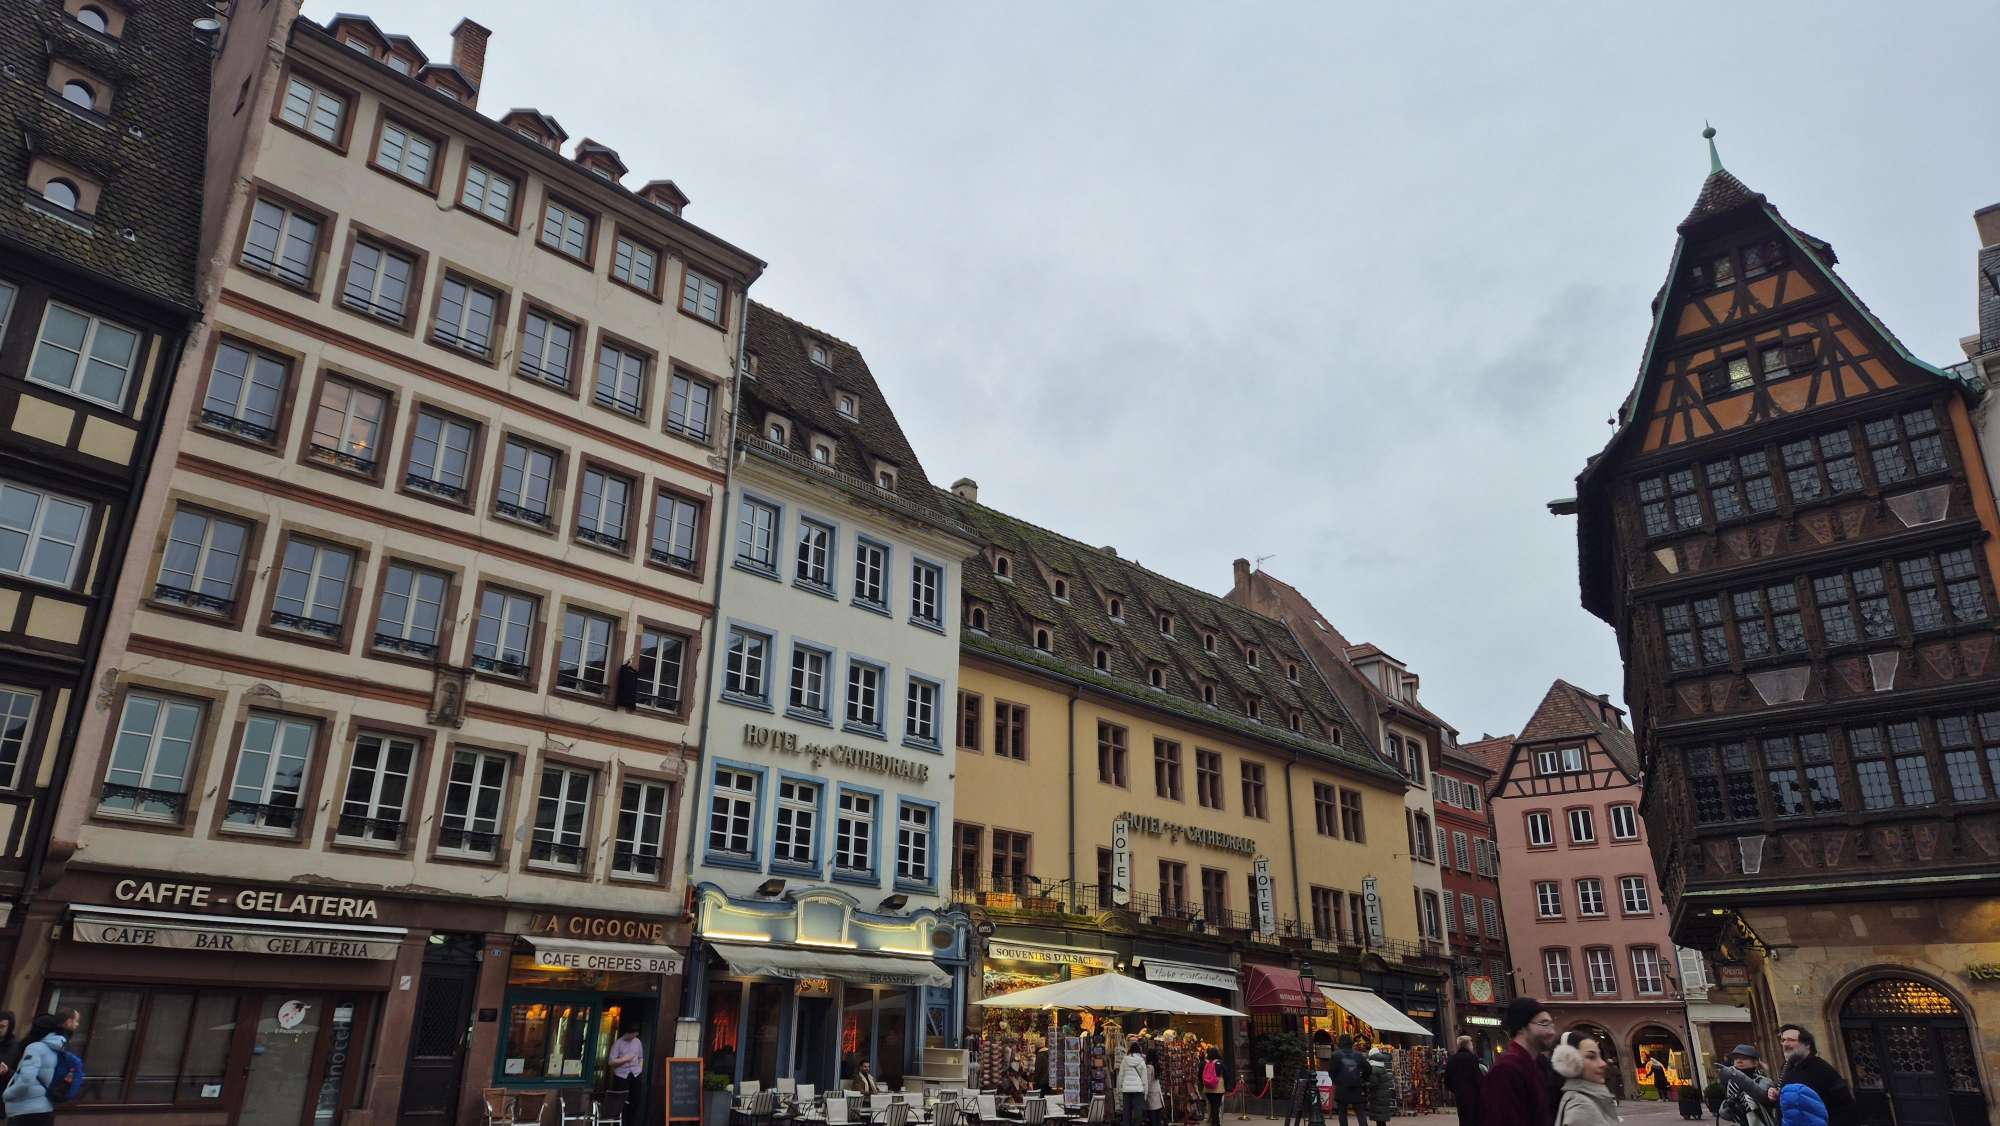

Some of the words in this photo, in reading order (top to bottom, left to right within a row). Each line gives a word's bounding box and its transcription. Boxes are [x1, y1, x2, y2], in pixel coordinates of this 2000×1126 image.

[743, 723, 800, 754] HOTEL
[115, 879, 212, 907] CAFFE
[235, 890, 378, 919] GELATERIA
[1257, 862, 1271, 925] HOTEL
[1365, 881, 1381, 937] HOTEL
[102, 927, 157, 945] CAFE
[195, 933, 235, 950] BAR
[267, 938, 369, 958] GELATERIA
[569, 916, 664, 940] CIGOGNE
[542, 952, 580, 968] CAFE
[587, 955, 642, 971] CREPES
[649, 959, 676, 973] BAR
[996, 948, 1052, 961] SOUVENIRS
[870, 974, 916, 985] BRASSERIE
